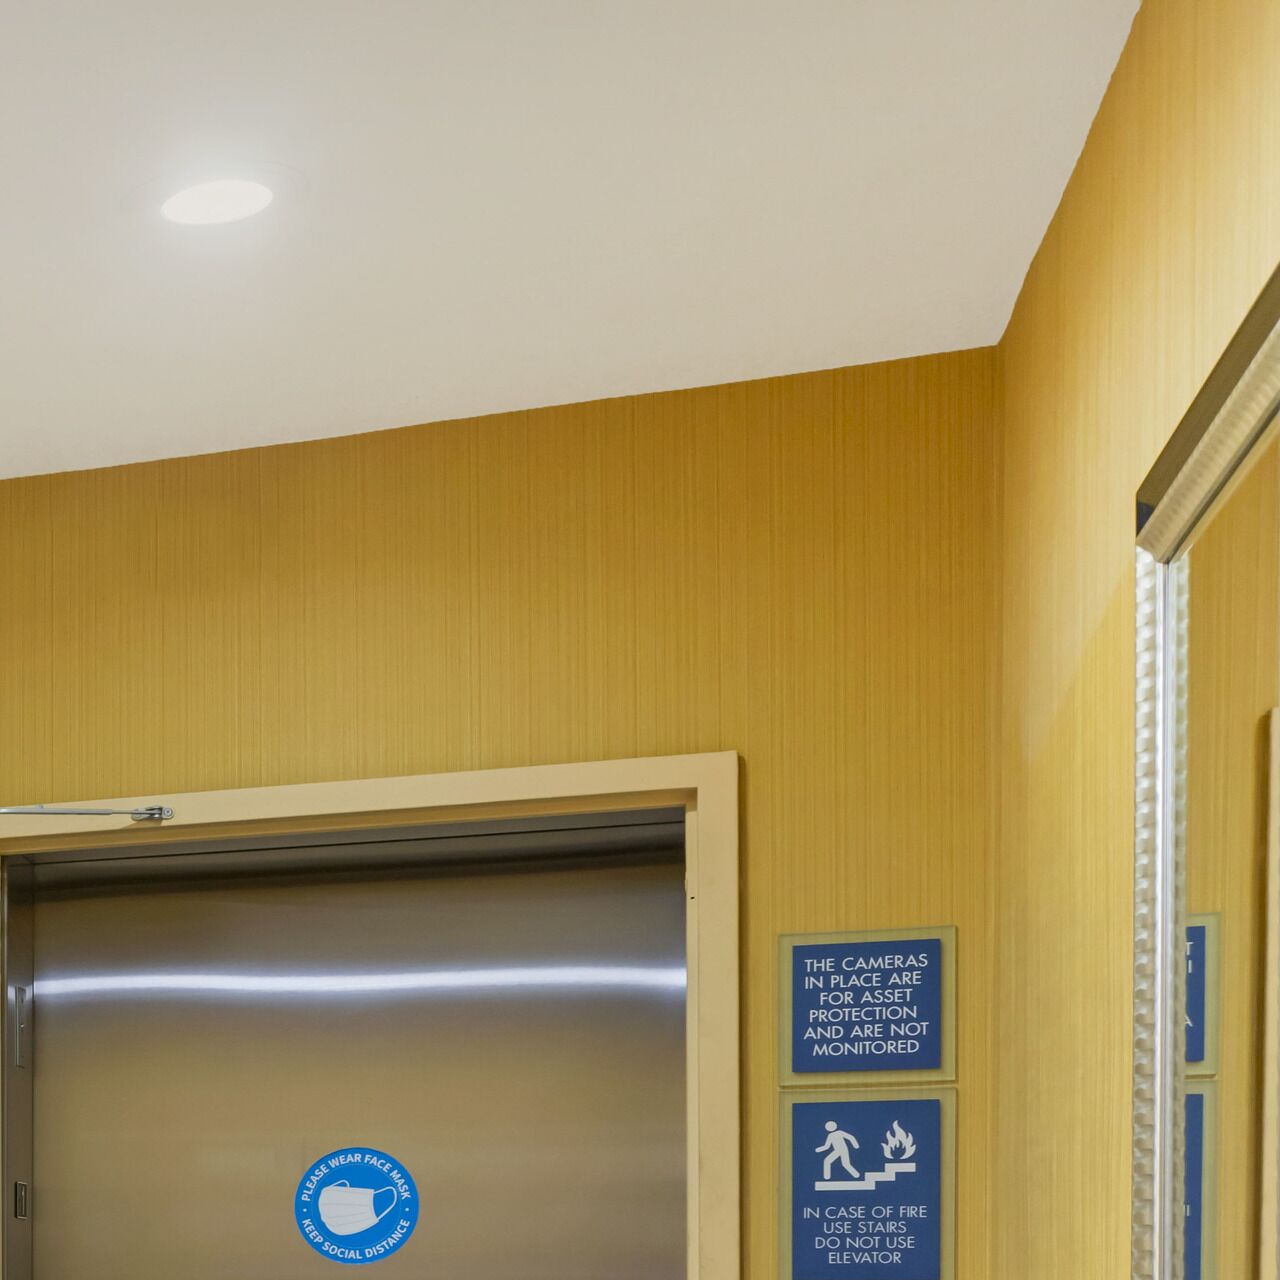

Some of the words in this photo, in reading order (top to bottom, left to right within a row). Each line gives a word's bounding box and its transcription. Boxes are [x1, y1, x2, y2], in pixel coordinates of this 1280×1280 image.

[804, 958, 834, 973] THE
[841, 954, 928, 971] CAMERAS
[804, 975, 823, 990] IN
[830, 973, 881, 988] PLACE
[888, 971, 922, 986] ARE
[820, 990, 853, 1006] FOR
[860, 989, 913, 1004] ASSET
[809, 1006, 917, 1023] PROTECTION
[803, 1025, 844, 1040] AND
[850, 1024, 883, 1039] ARE
[890, 1022, 930, 1037] NOT
[812, 1040, 920, 1057] MONITORED
[301, 1163, 330, 1202] PLEASE
[328, 1153, 362, 1169] WEAR
[364, 1154, 392, 1173] FACE
[389, 1169, 411, 1200] MASK
[803, 1207, 820, 1219] IN
[825, 1206, 866, 1219] CASE
[871, 1206, 894, 1219] OF
[899, 1206, 928, 1218] FIRE
[823, 1221, 853, 1234] USE
[857, 1221, 907, 1234] STAIRS
[301, 1218, 324, 1244] KEEP
[321, 1241, 363, 1260] SOCIAL
[365, 1219, 411, 1258] DISTANCE
[814, 1236, 840, 1249] DO
[845, 1236, 881, 1249] NOT
[886, 1236, 915, 1248] USE
[828, 1251, 902, 1264] ELEVATOR
